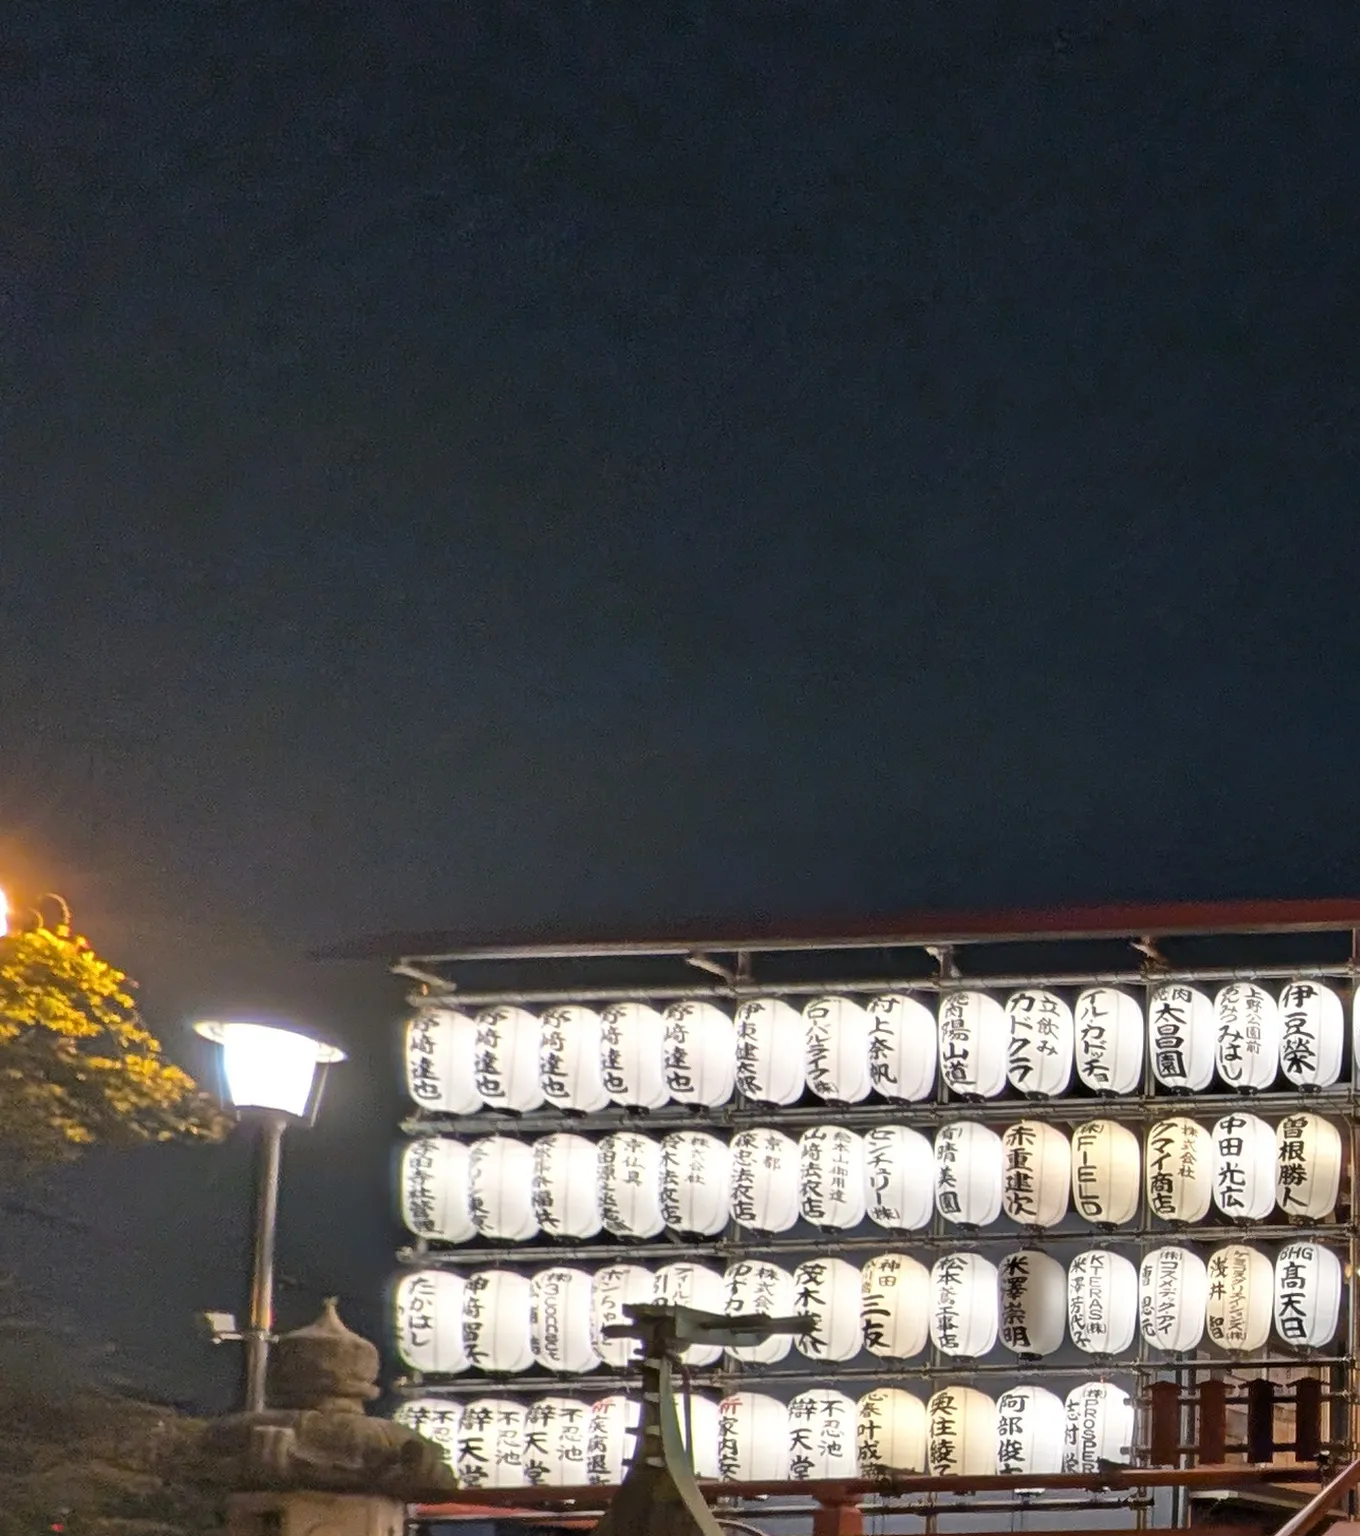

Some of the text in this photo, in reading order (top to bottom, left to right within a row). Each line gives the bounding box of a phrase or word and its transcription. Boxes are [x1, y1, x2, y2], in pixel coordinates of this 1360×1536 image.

[1008, 993, 1035, 1083] カドクラ
[1036, 995, 1061, 1056] 立飲み
[1154, 1003, 1187, 1079] 太昌園
[1243, 988, 1263, 1055] 上野公園前
[763, 1135, 784, 1171] 京都
[1150, 1120, 1178, 1215] クマイ商店
[1178, 1123, 1199, 1181] 株式会社
[1218, 1116, 1248, 1209] 中田光広
[753, 1267, 781, 1312] 株式会
[879, 1259, 901, 1287] 神田
[860, 1294, 891, 1348] 三友
[495, 1411, 522, 1466] 不忍池
[557, 1408, 584, 1462] 不忍池
[718, 1398, 743, 1482] 祈家内安
[819, 1400, 845, 1457] 不忍池
